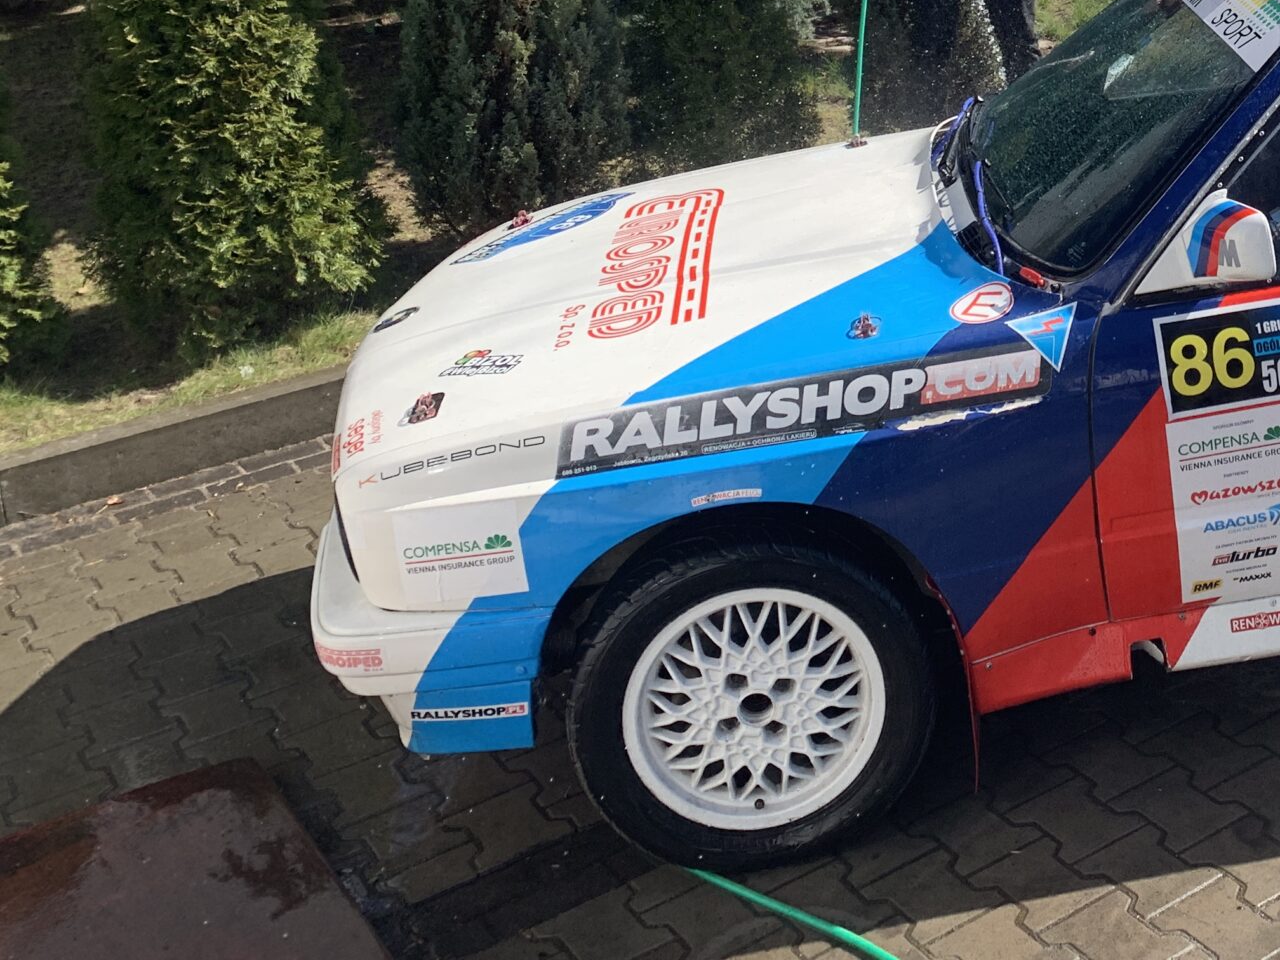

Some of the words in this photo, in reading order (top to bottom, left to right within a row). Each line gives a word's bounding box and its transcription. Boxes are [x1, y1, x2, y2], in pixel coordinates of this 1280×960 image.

[1211, 8, 1262, 50] SPORT
[587, 188, 718, 339] EUROSPED
[1217, 239, 1242, 269] M
[1255, 322, 1263, 335] 1
[467, 354, 524, 367] BIZOL
[1169, 326, 1256, 397] 86
[702, 440, 747, 453] RENOWACJA
[751, 434, 785, 446] OCHRONA
[784, 430, 816, 442] LAKIERU
[1177, 431, 1261, 457] COMPENSA
[1179, 459, 1213, 472] VIENNA
[1213, 450, 1263, 467] INSURANCE
[1203, 511, 1268, 534] ABACUS
[402, 539, 482, 560] COMPENSA
[406, 564, 437, 575] VIENNA
[437, 557, 486, 572] INSURANCE
[485, 554, 516, 566] GROUP
[1192, 579, 1222, 593] RMF
[1238, 571, 1273, 585] MAXXX
